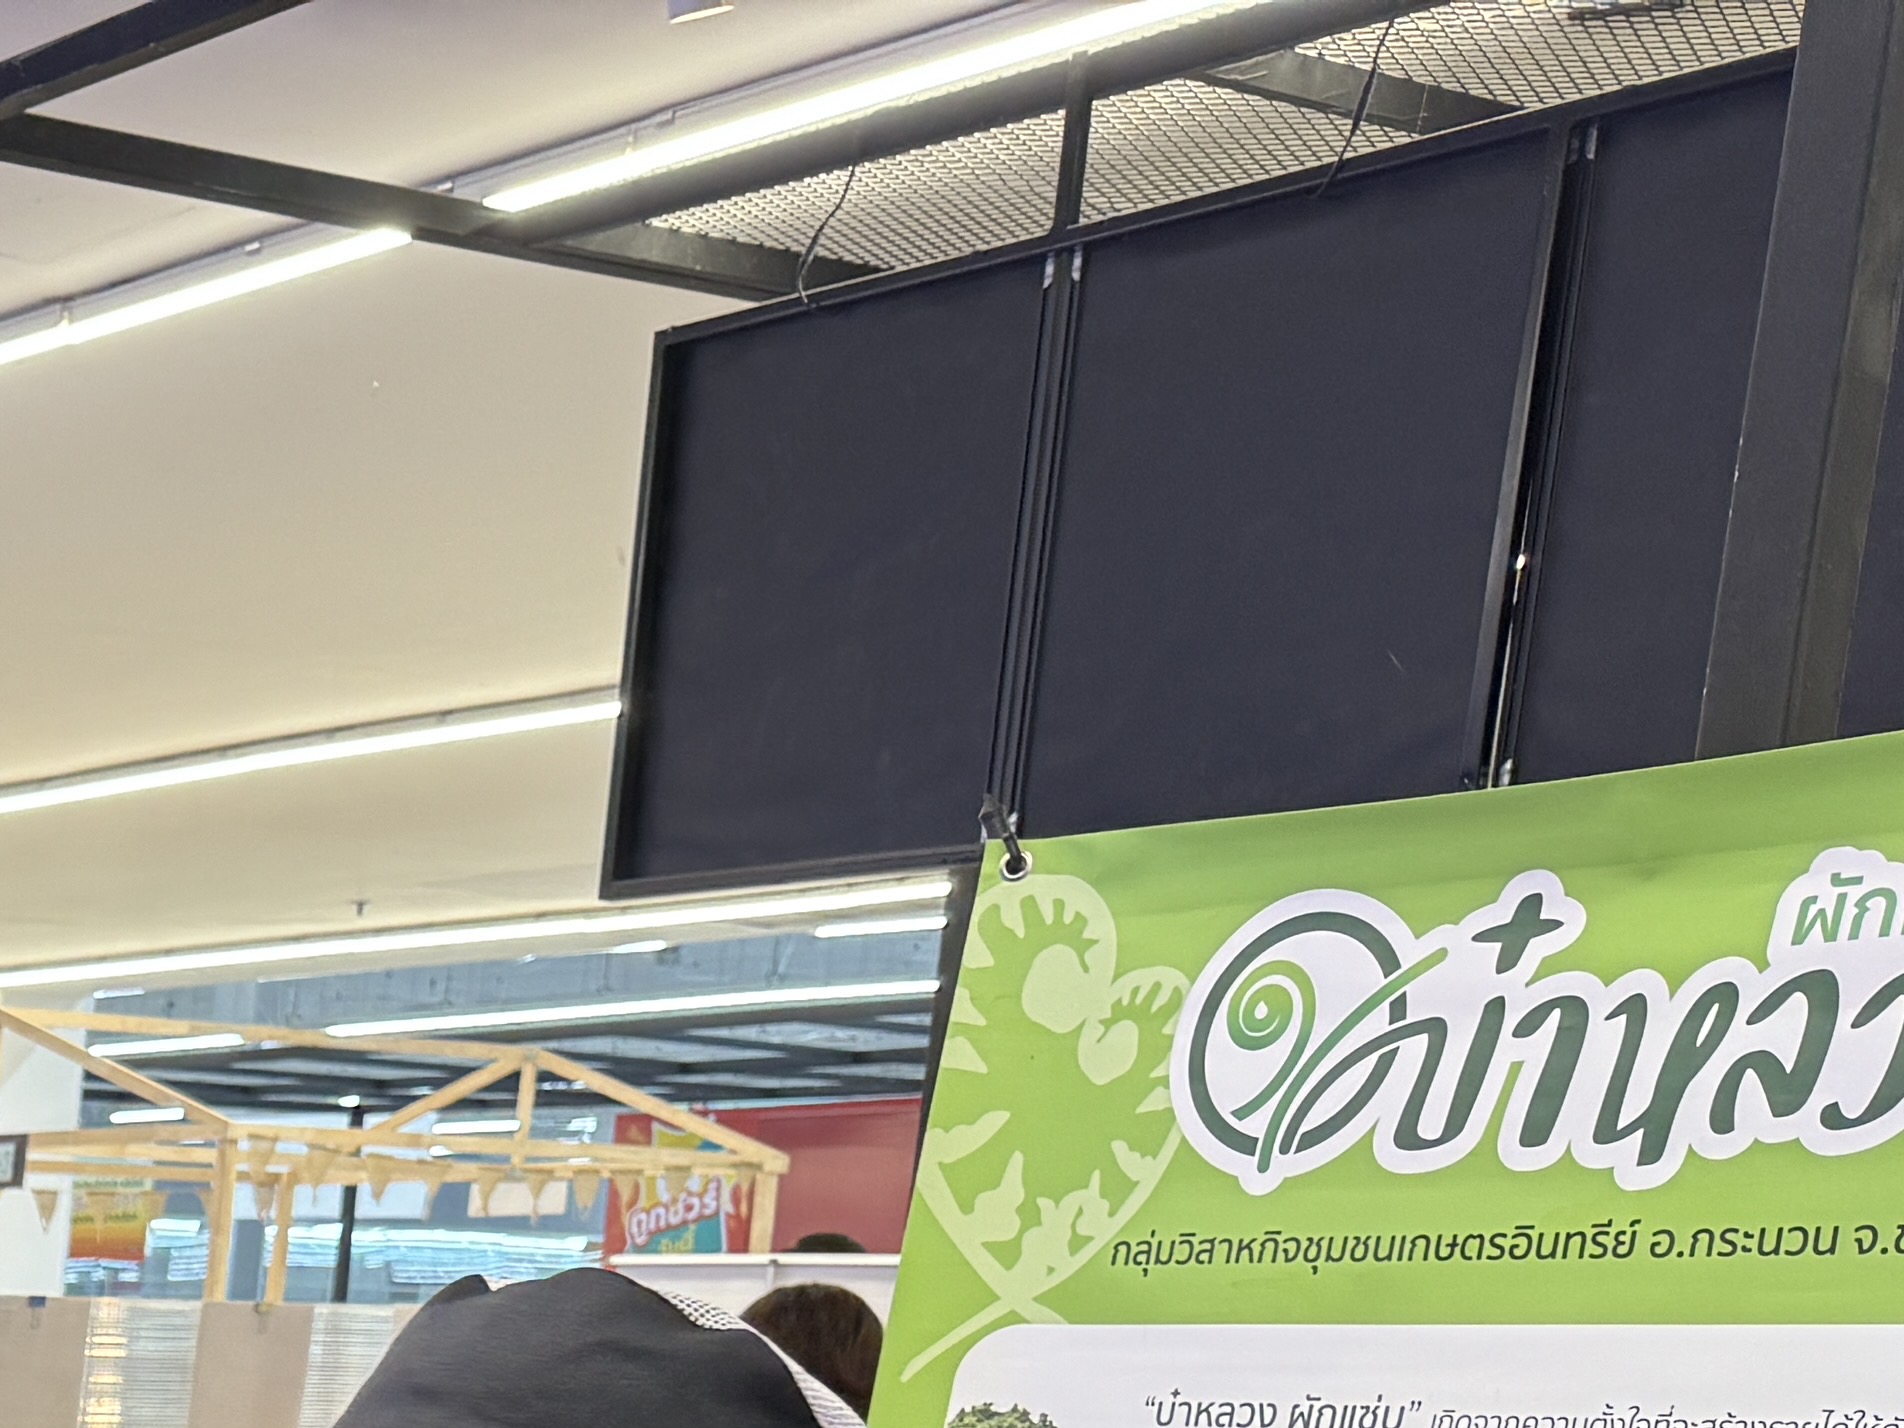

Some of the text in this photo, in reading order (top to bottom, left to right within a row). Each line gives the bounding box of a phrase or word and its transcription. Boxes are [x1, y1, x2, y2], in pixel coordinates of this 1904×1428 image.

[1790, 872, 1904, 947] ผัก
[1111, 1216, 1641, 1278] กลุ่มวิสาหกิจชุมชนเกษตรอินทรีย์
[1649, 1224, 1839, 1261] อ.กระนวน
